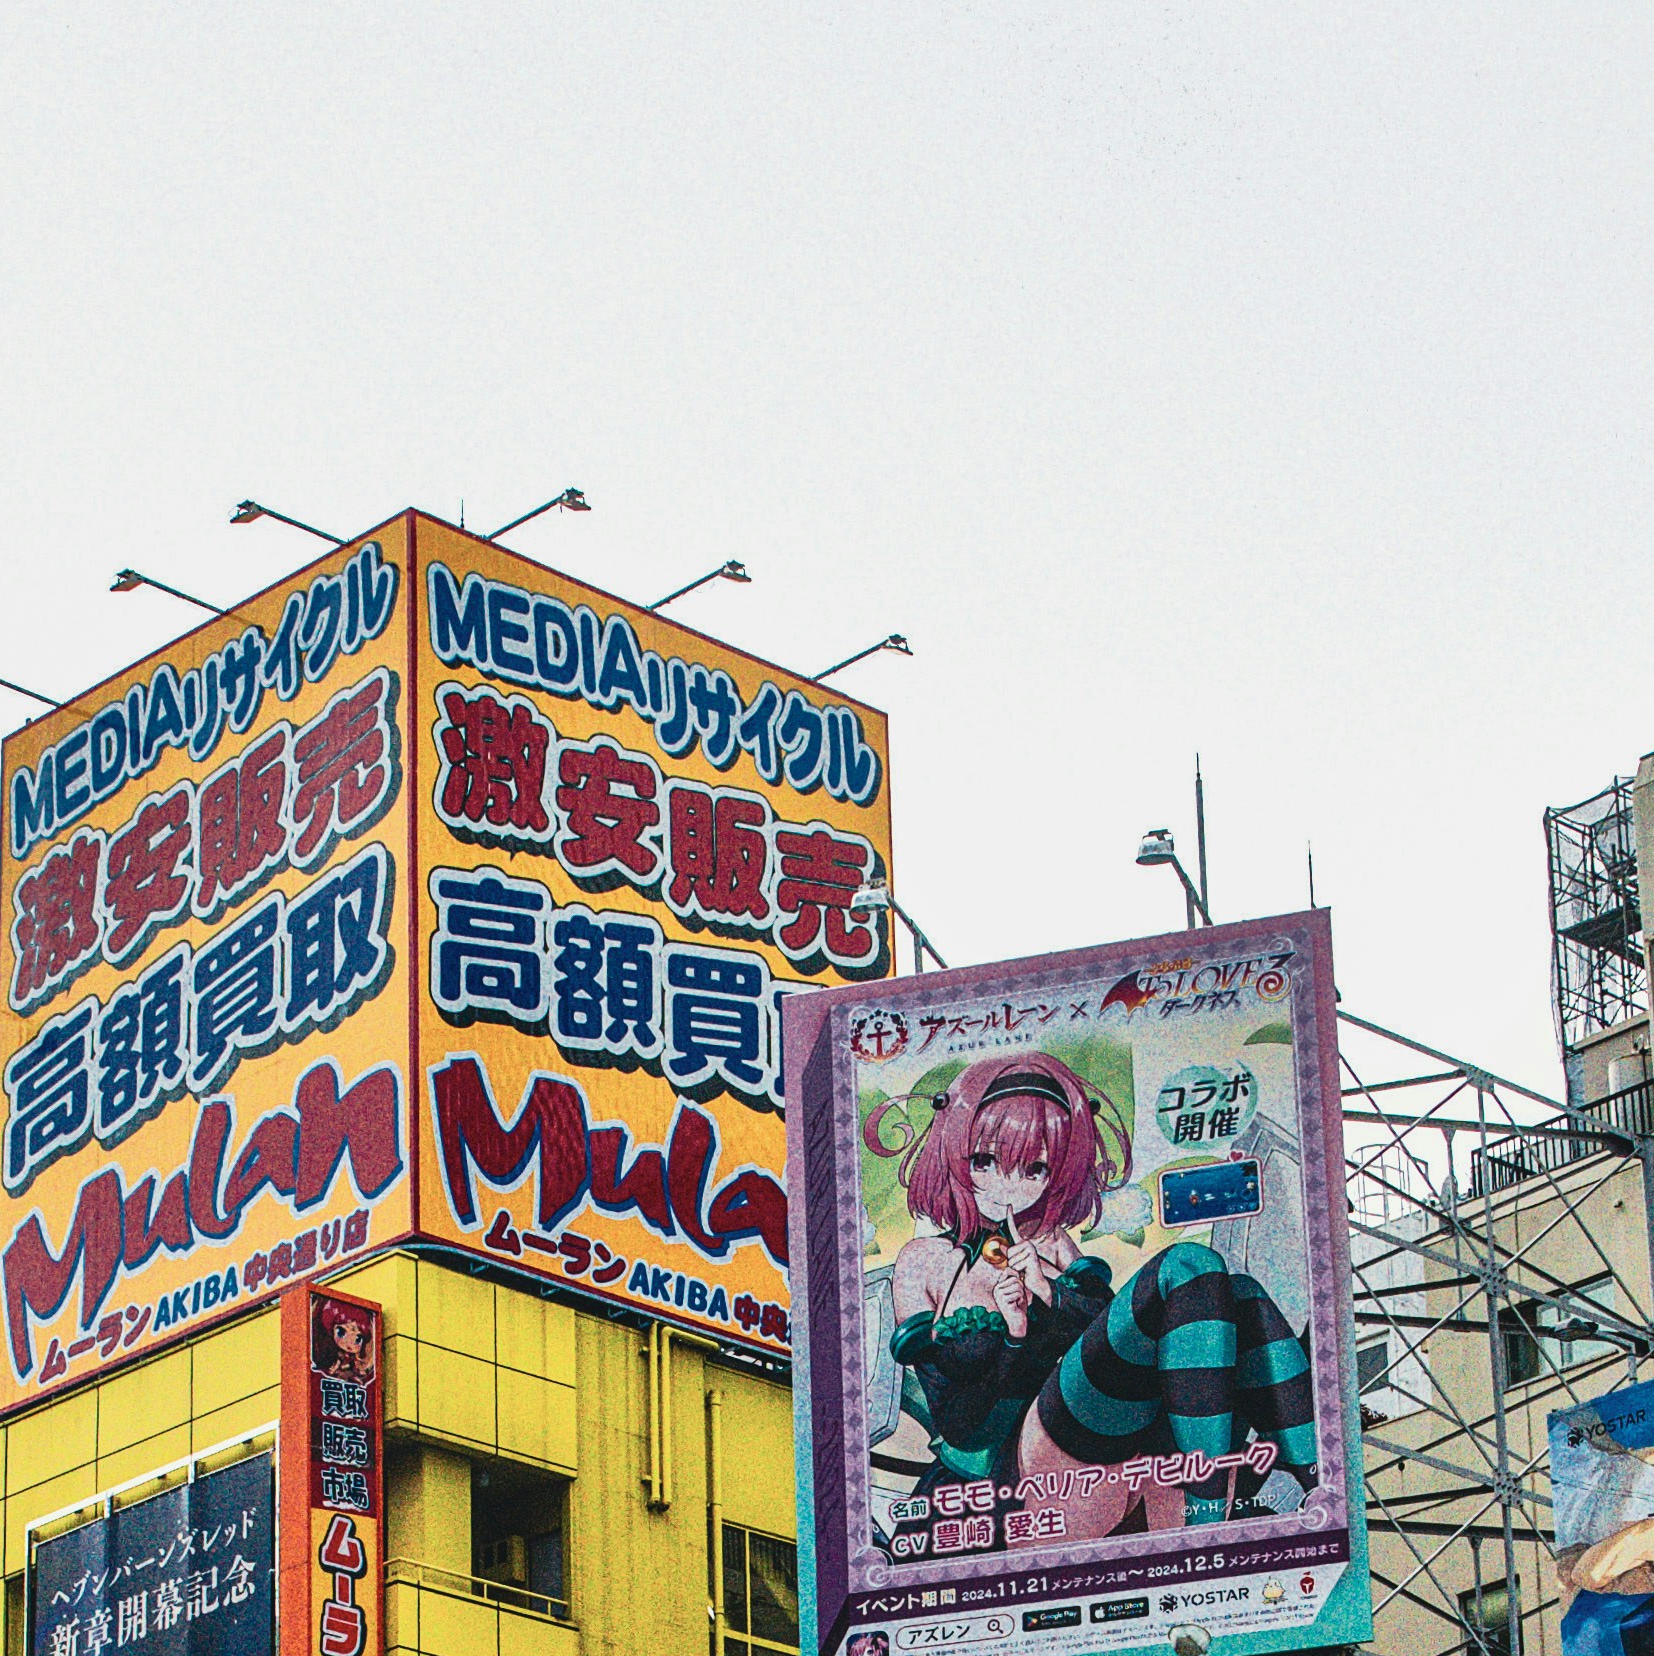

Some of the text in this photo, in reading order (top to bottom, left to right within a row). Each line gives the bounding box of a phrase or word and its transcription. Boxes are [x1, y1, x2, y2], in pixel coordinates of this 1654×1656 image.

[11, 542, 401, 857] MEDIAリサイクル
[429, 567, 879, 802] MEDIAリサイクル
[15, 668, 389, 998] 激安販売
[441, 693, 877, 962] 激安販売
[7, 850, 385, 1185] 高額買取
[437, 874, 785, 1108] 高額買
[918, 1003, 1061, 1054] アズールレーン
[1157, 1073, 1252, 1114] コラボ
[1173, 1107, 1240, 1145] 開催
[6, 1062, 403, 1380] Mulan
[40, 1210, 368, 1381] ムーラン AKIBA 中央通り店
[486, 1212, 791, 1340] ムーラン AKIBA 中央
[320, 1378, 369, 1420] 買取
[1585, 1409, 1646, 1443] YOSTAR
[321, 1422, 368, 1466] 販売
[321, 1469, 370, 1510] 市場
[890, 1499, 928, 1520] 名前
[50, 1505, 258, 1606] ヘブンバーンズレッド
[892, 1534, 925, 1556] CV
[855, 1589, 957, 1615] イベント期間
[961, 1575, 1049, 1603] 2024.11.21
[1147, 1553, 1225, 1579] 2024.12.5
[1179, 1587, 1250, 1607] YOSTAR
[907, 1623, 972, 1646] アズレン
